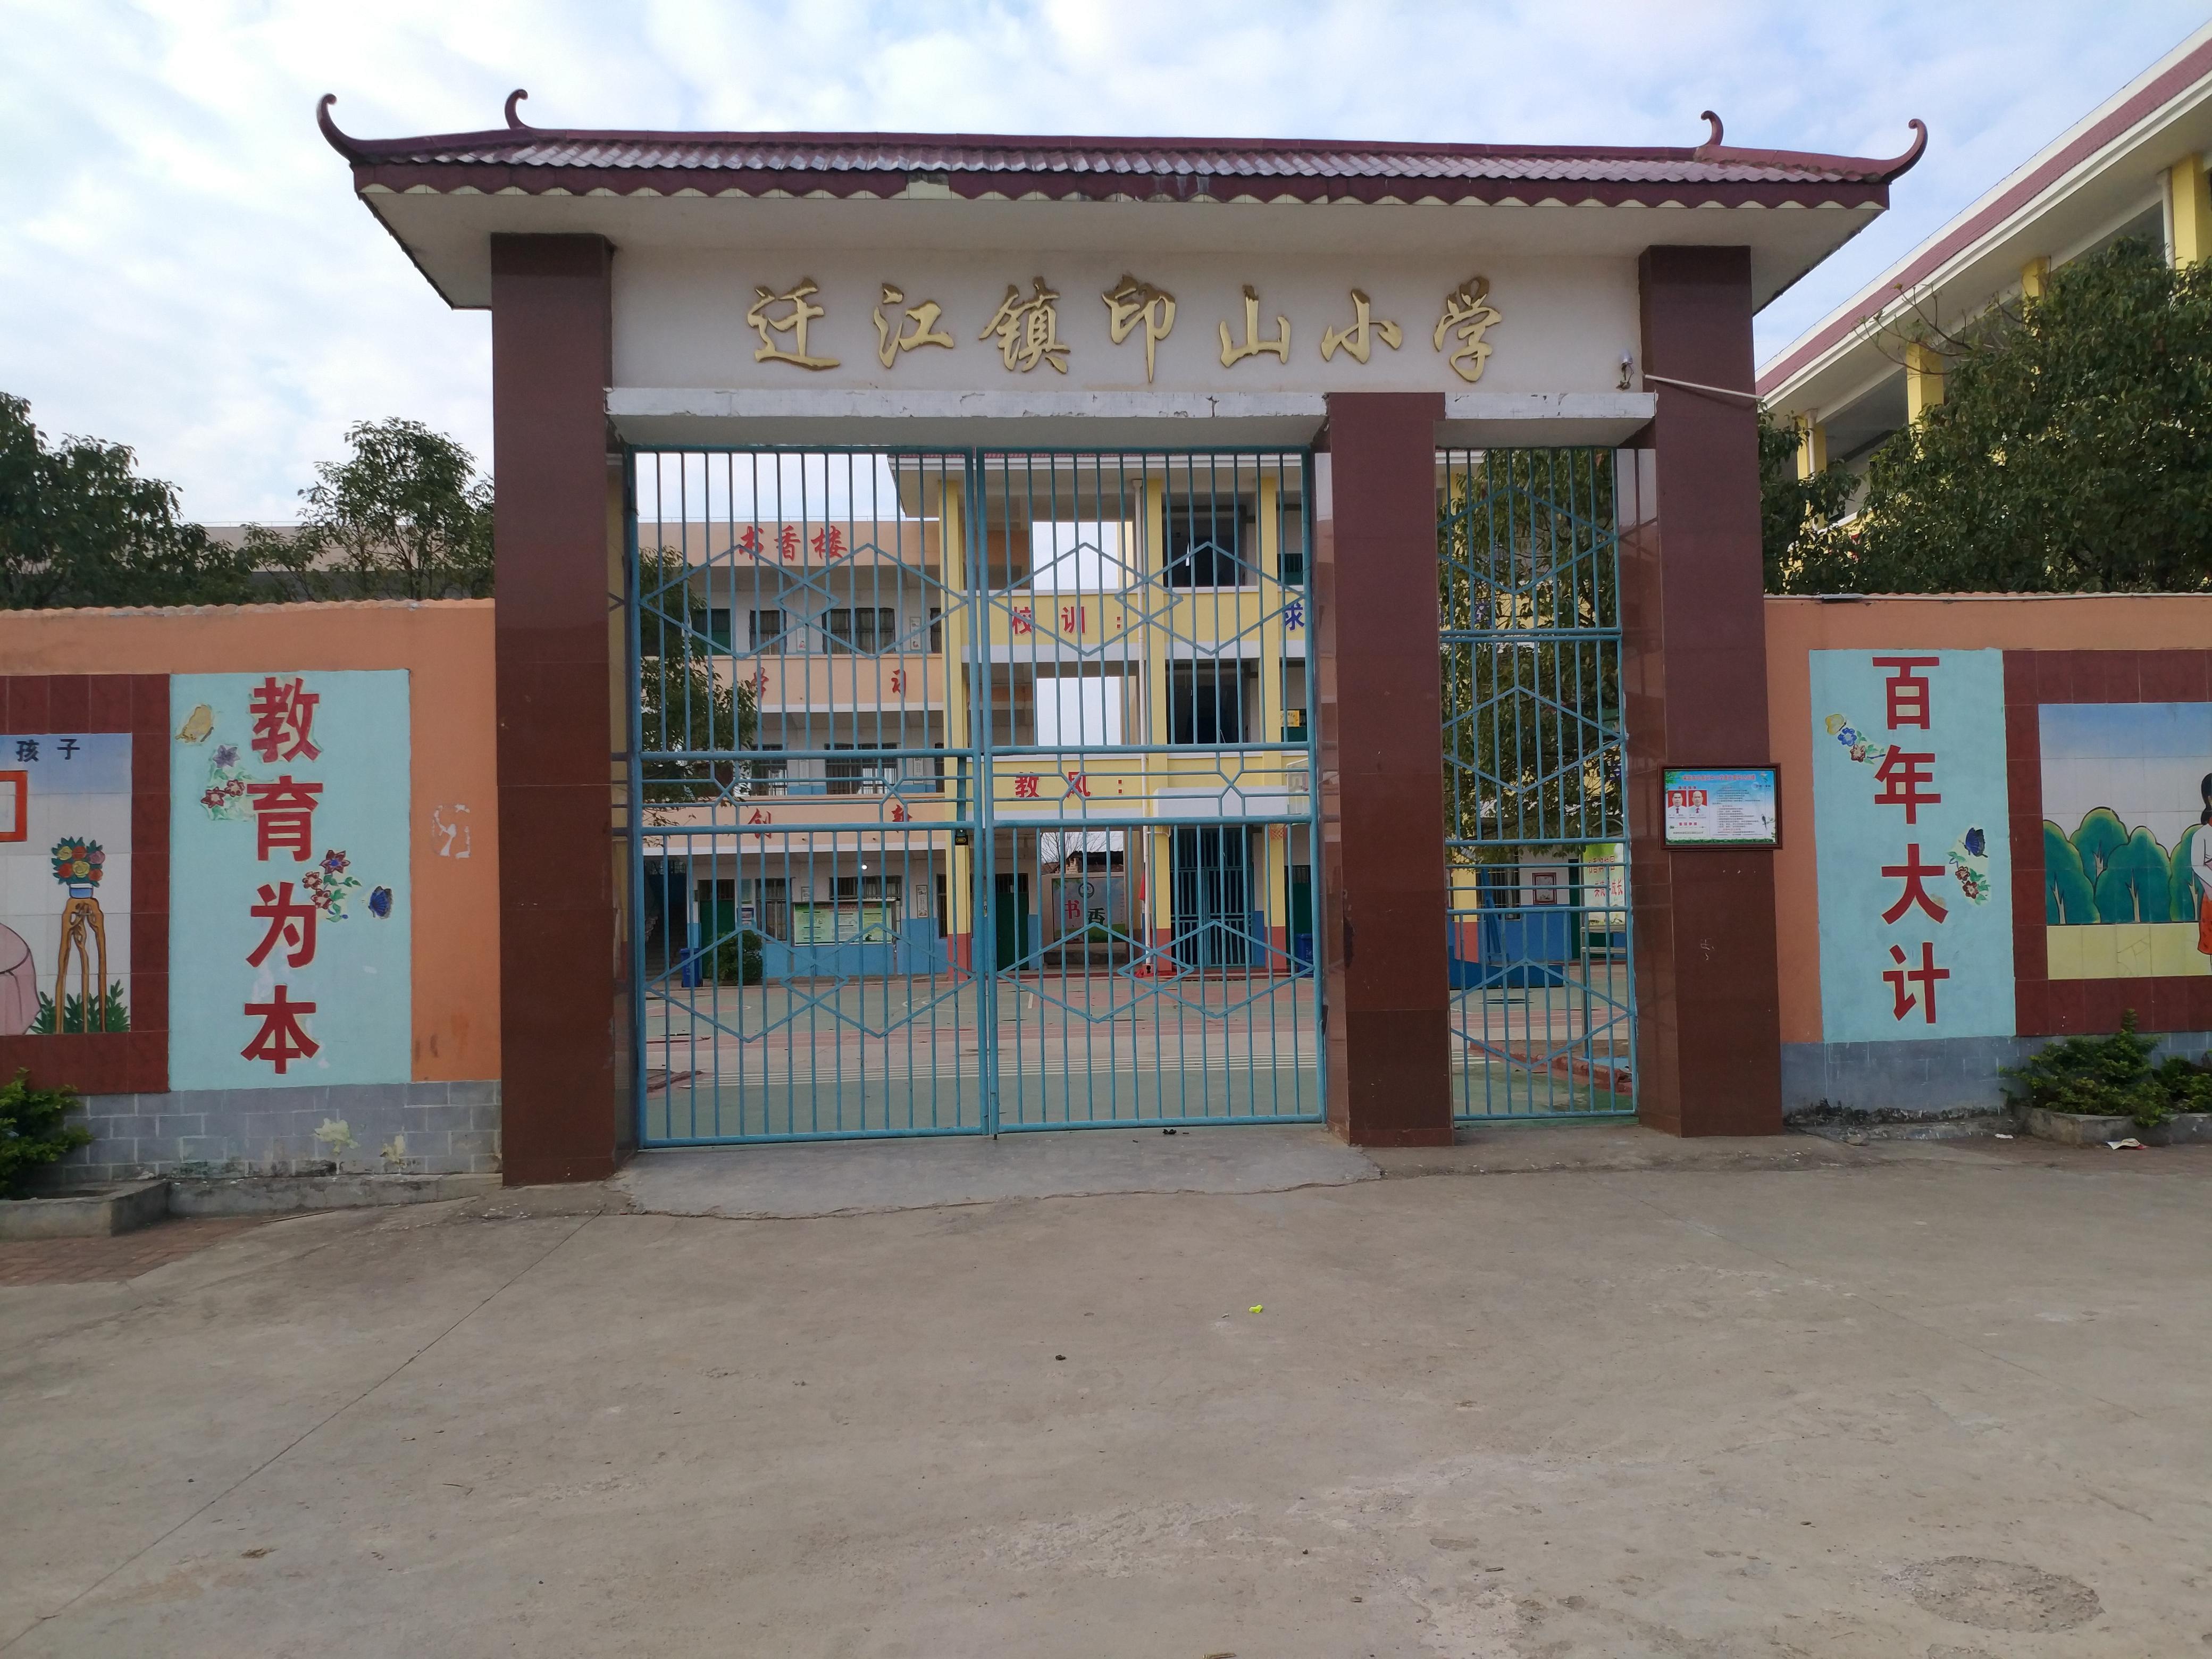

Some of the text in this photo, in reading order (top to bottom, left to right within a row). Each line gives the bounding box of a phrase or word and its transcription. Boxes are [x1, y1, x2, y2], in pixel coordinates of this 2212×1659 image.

[747, 274, 1503, 383] 迁江镇印山小学
[739, 525, 847, 561] 书香楼
[15, 738, 81, 762] 孩子
[241, 676, 323, 1074] 教育为本
[1872, 656, 1949, 1024] 百年大计
